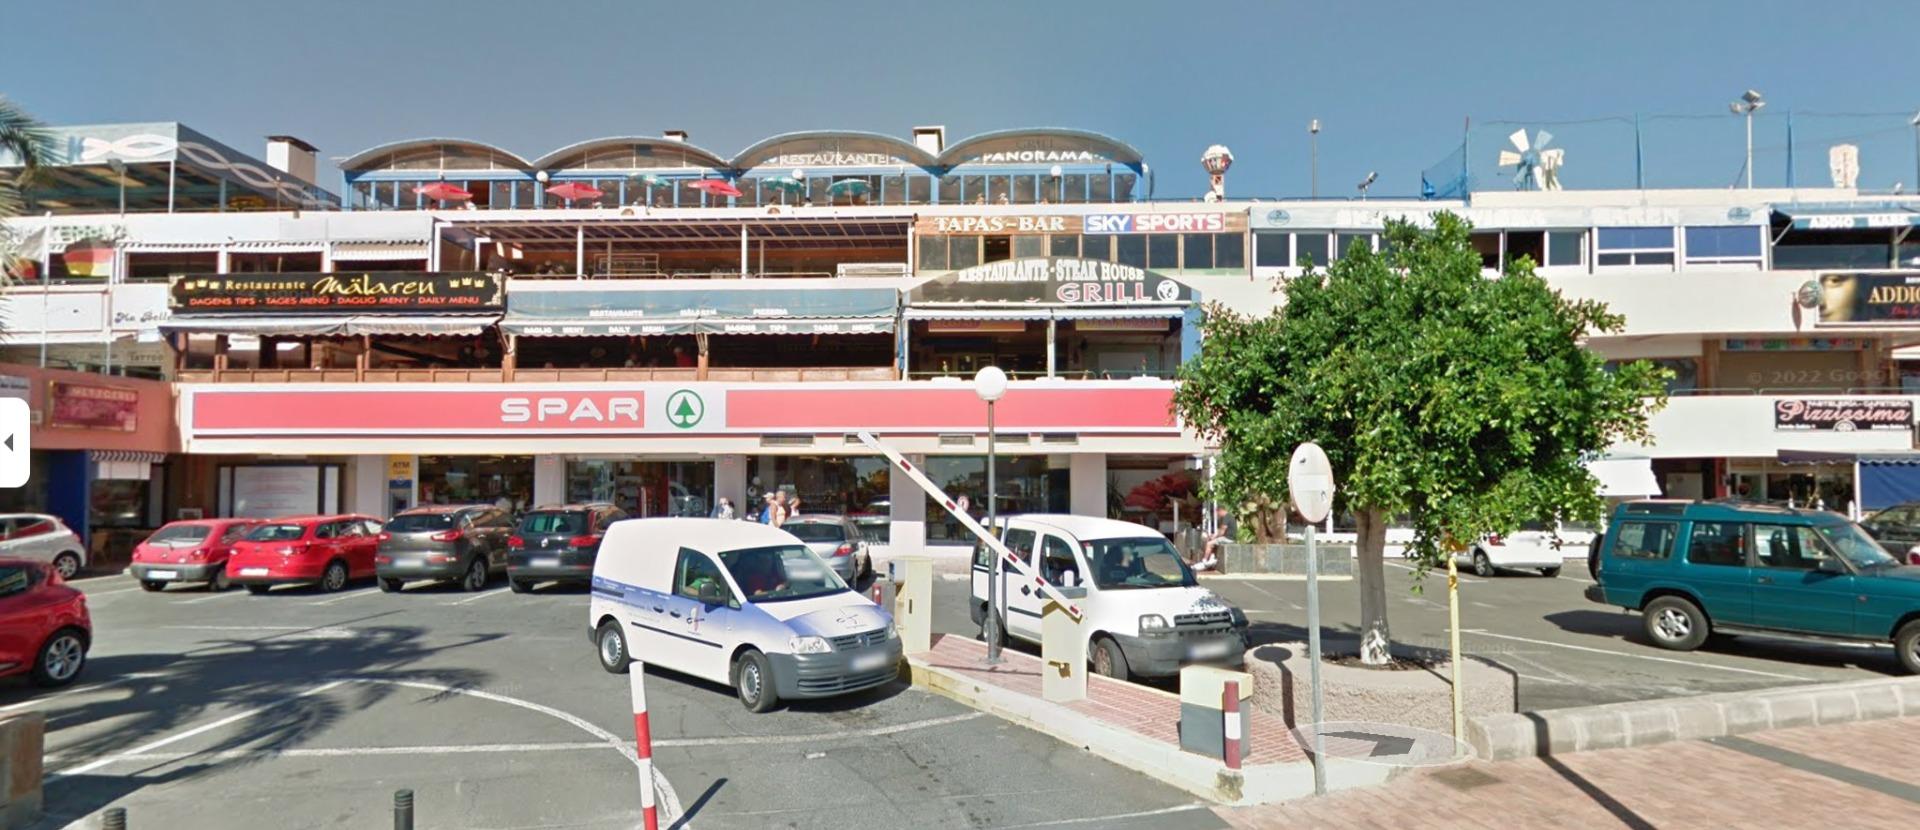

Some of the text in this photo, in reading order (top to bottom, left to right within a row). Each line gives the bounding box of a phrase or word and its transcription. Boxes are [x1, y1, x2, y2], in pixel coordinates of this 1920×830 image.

[1087, 213, 1223, 230] SKY SPORTS
[1055, 260, 1098, 281] STEAK
[1100, 264, 1145, 281] HOUSE
[225, 280, 306, 290] Restaurante
[312, 274, 435, 295] Mälaren
[1056, 282, 1152, 302] GRILL
[190, 297, 232, 306] DAGENS
[236, 297, 256, 305] TIPS
[265, 297, 297, 305] TAGES
[418, 296, 445, 304] DAILY
[449, 296, 480, 304] MENU
[501, 398, 639, 421] SPAR
